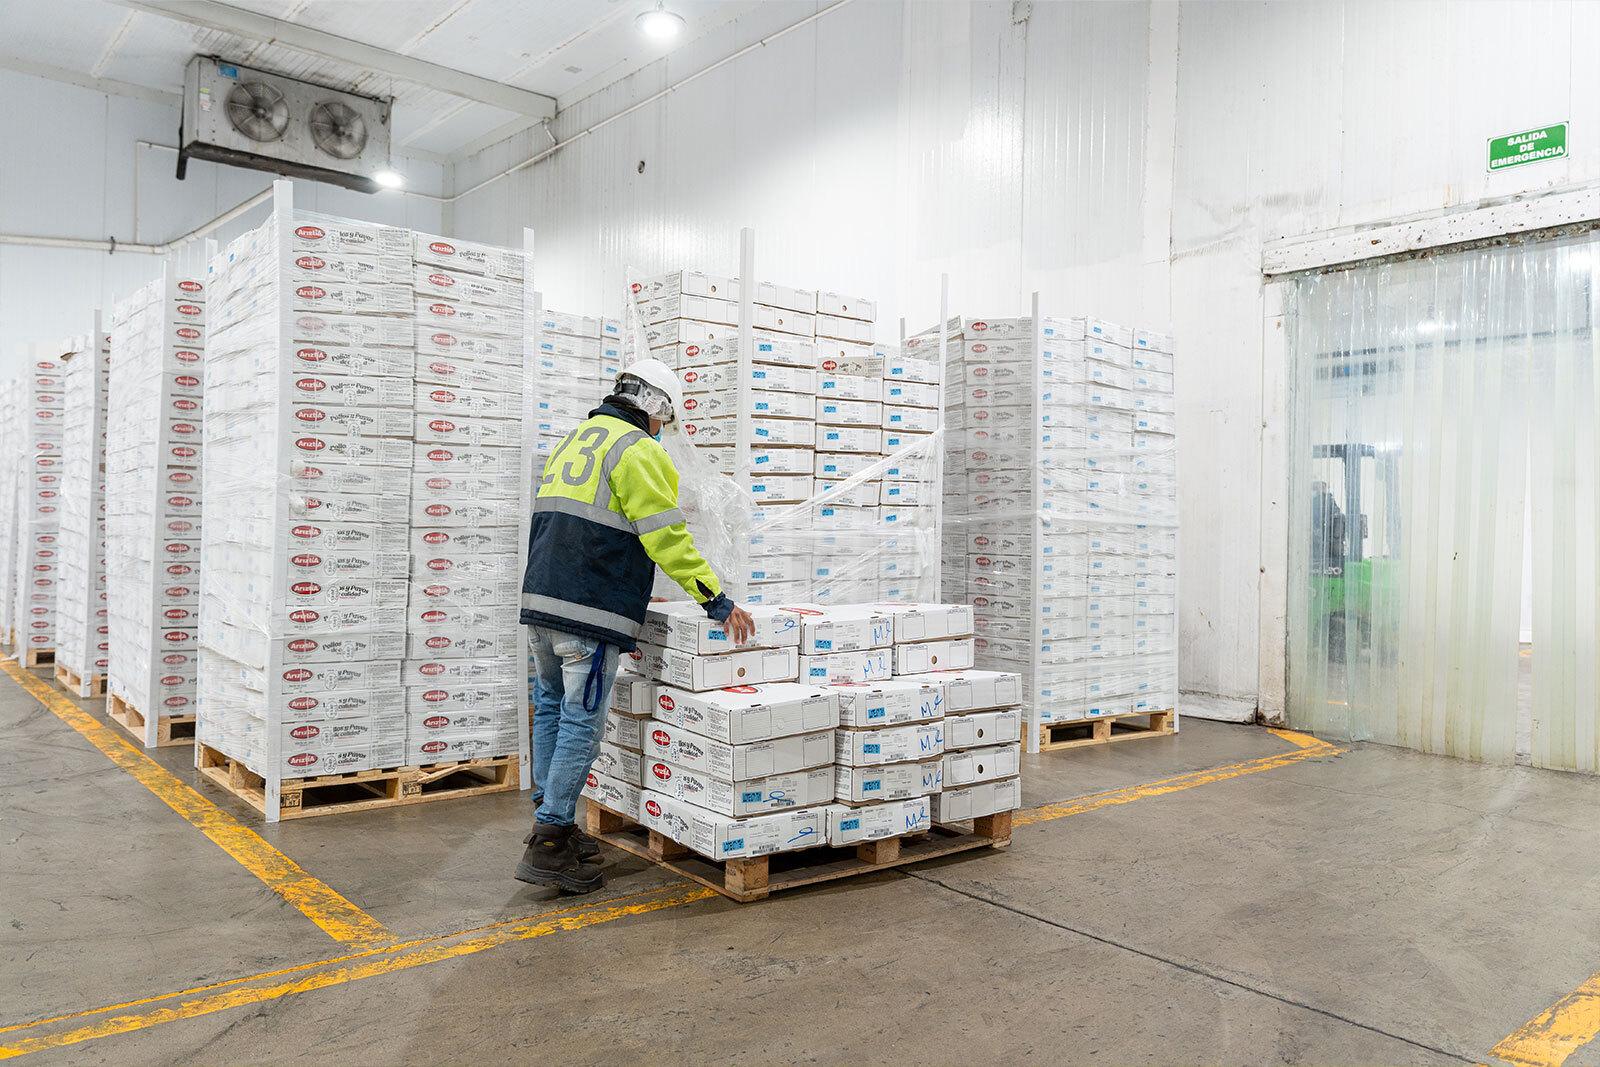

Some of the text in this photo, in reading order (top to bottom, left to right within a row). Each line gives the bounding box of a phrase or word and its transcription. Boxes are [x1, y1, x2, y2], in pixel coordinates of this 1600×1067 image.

[1507, 131, 1548, 146] SALIDA
[1519, 142, 1535, 153] DE
[1491, 146, 1564, 167] EMERGENCIA
